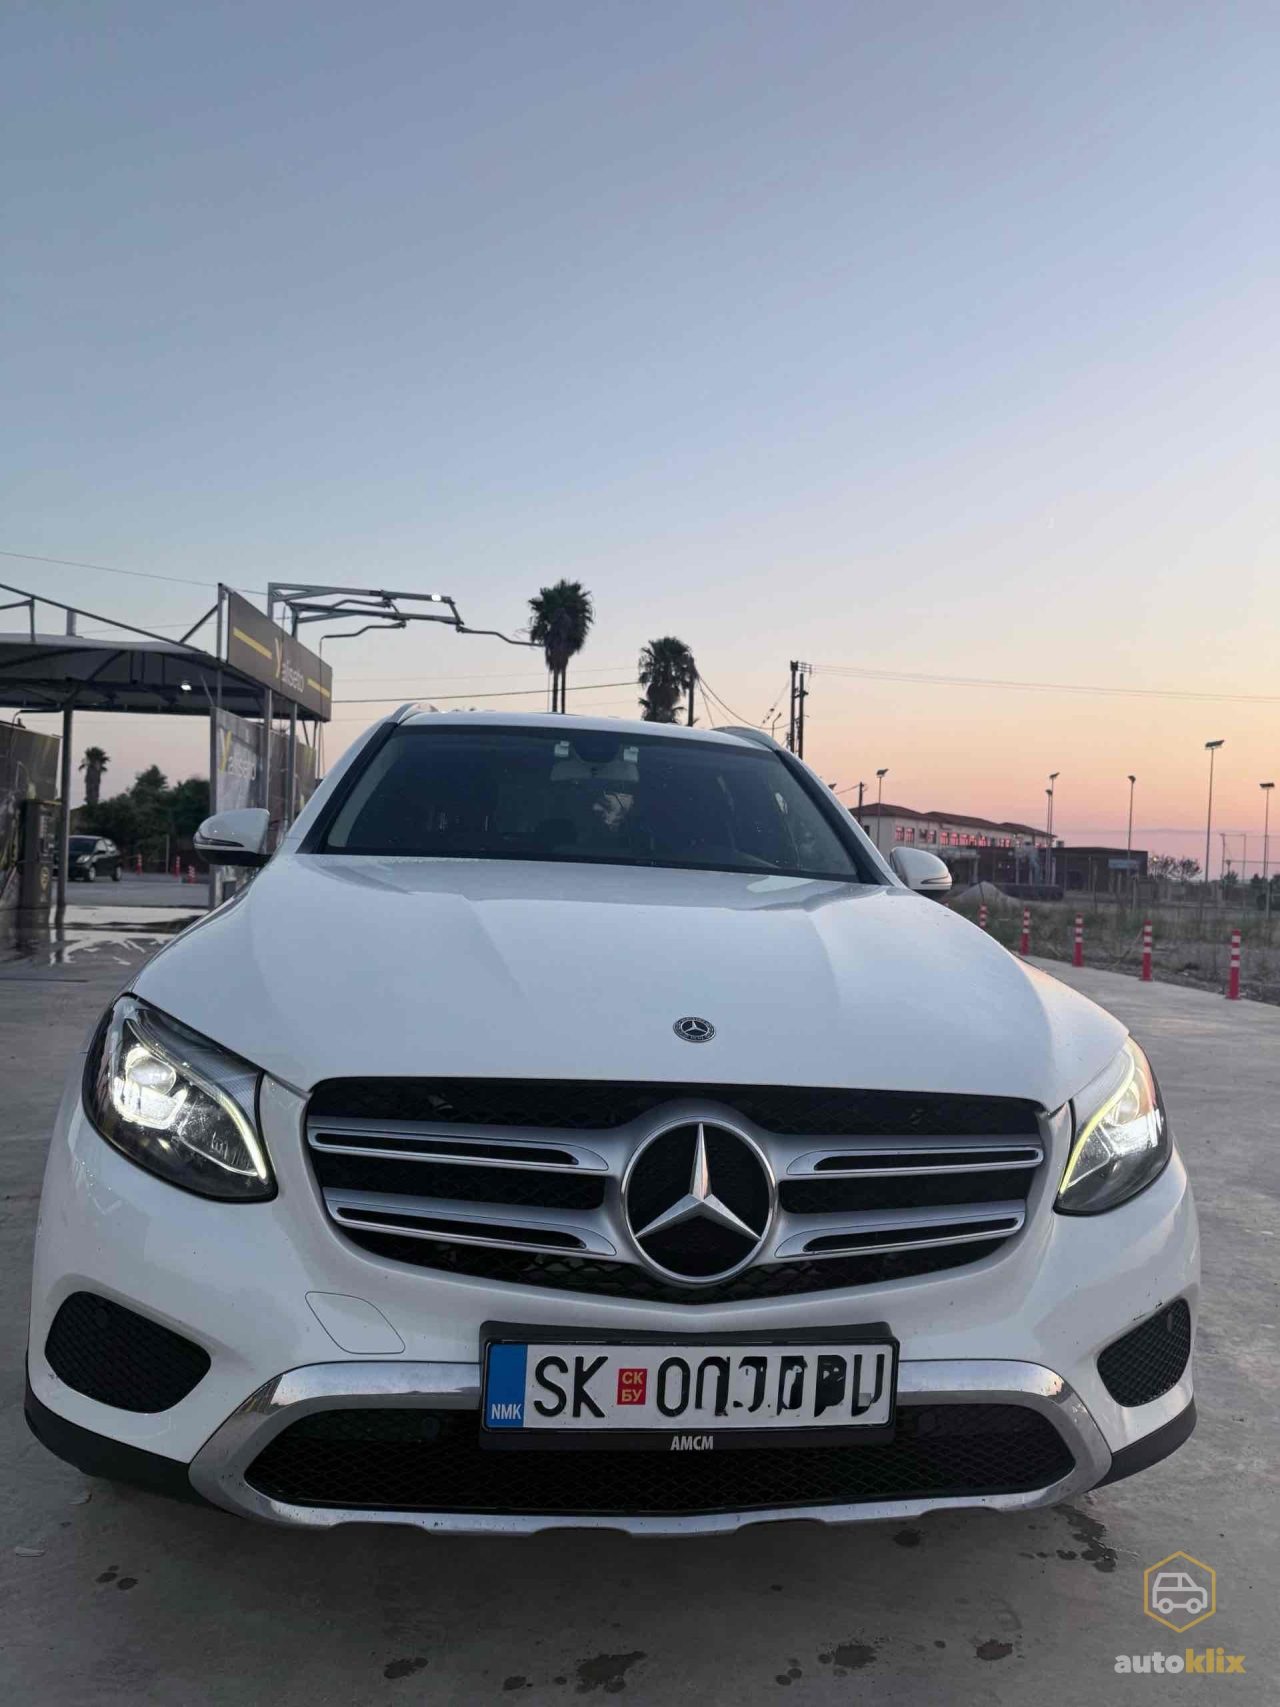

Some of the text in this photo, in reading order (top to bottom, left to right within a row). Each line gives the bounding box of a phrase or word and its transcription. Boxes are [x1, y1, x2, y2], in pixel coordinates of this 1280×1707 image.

[533, 1355, 608, 1418] SK
[491, 1403, 522, 1421] NMK
[670, 1435, 714, 1451] AMCM
